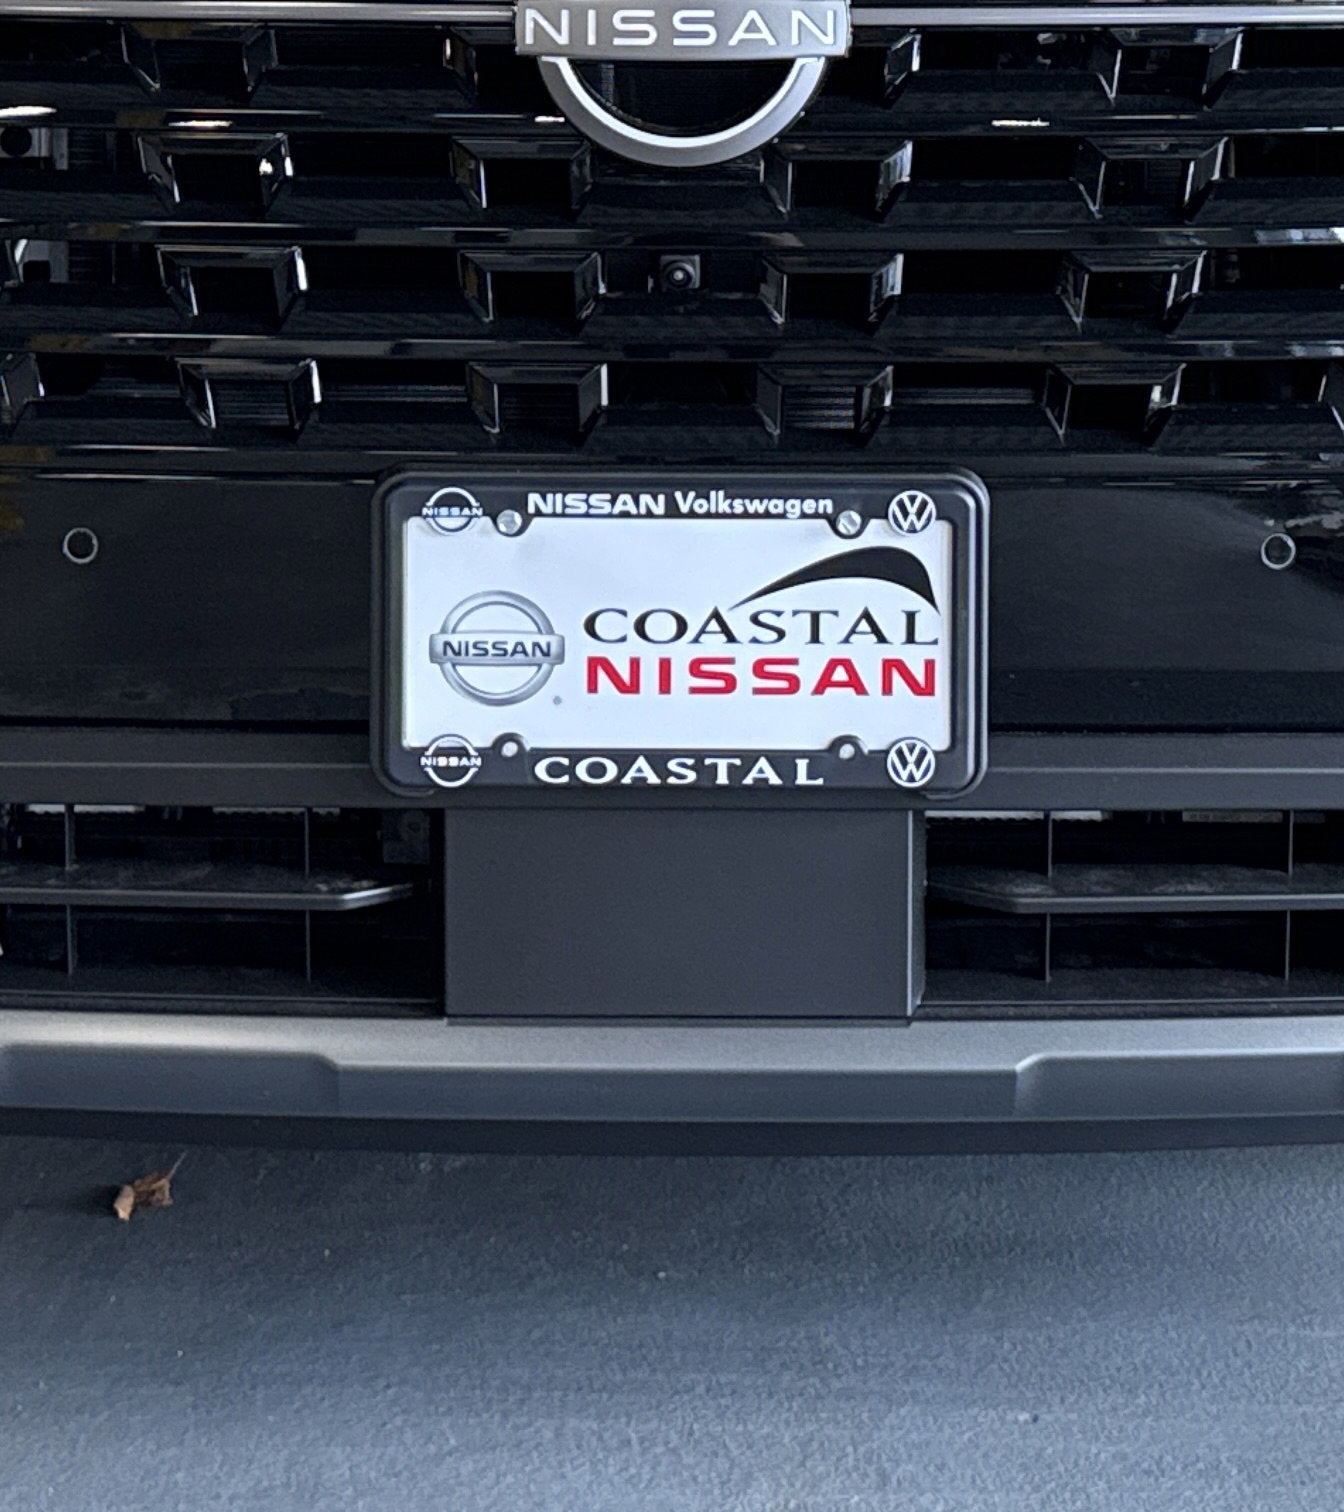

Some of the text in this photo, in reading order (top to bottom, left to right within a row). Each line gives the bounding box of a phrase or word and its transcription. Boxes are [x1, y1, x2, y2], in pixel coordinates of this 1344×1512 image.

[524, 8, 837, 46] NISSAN
[421, 506, 483, 516] NISSAN
[527, 490, 834, 518] NISSAN Volkswagen
[583, 606, 939, 646] COASTAL
[442, 639, 552, 658] NISSAN
[586, 656, 936, 697] NISSAN
[419, 756, 482, 767] NISSAN
[534, 754, 825, 787] COASTAL
